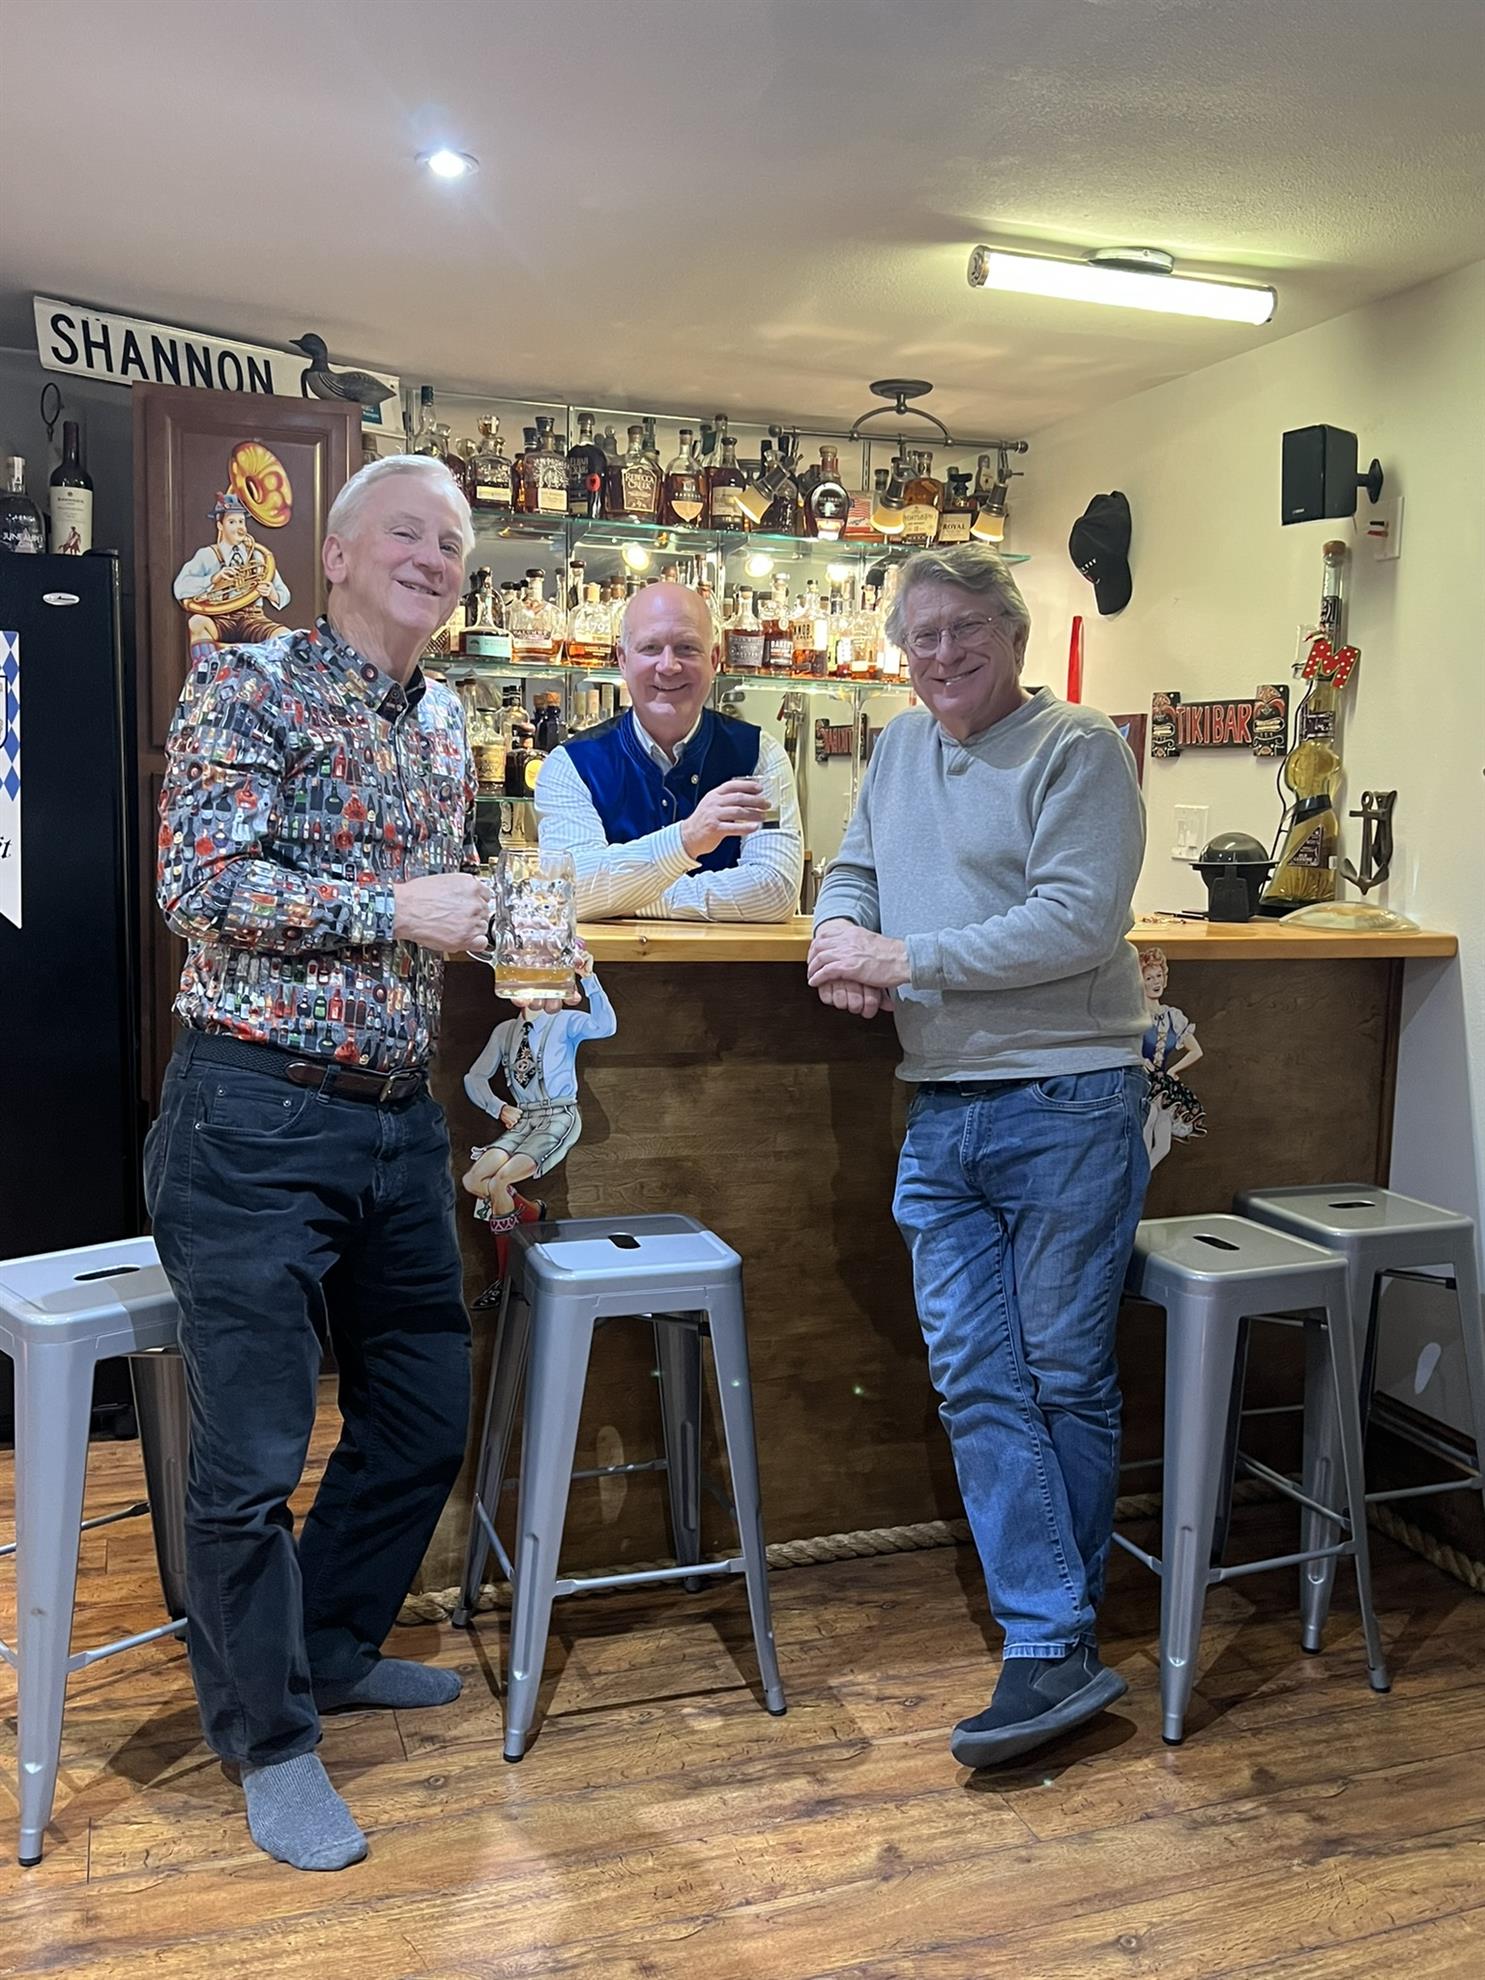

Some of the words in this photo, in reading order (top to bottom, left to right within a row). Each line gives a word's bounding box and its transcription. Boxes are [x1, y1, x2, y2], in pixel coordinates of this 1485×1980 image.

[50, 313, 273, 395] SHANNON
[1301, 639, 1361, 689] M
[1175, 705, 1209, 745] TIKI
[1213, 703, 1252, 744] BAR
